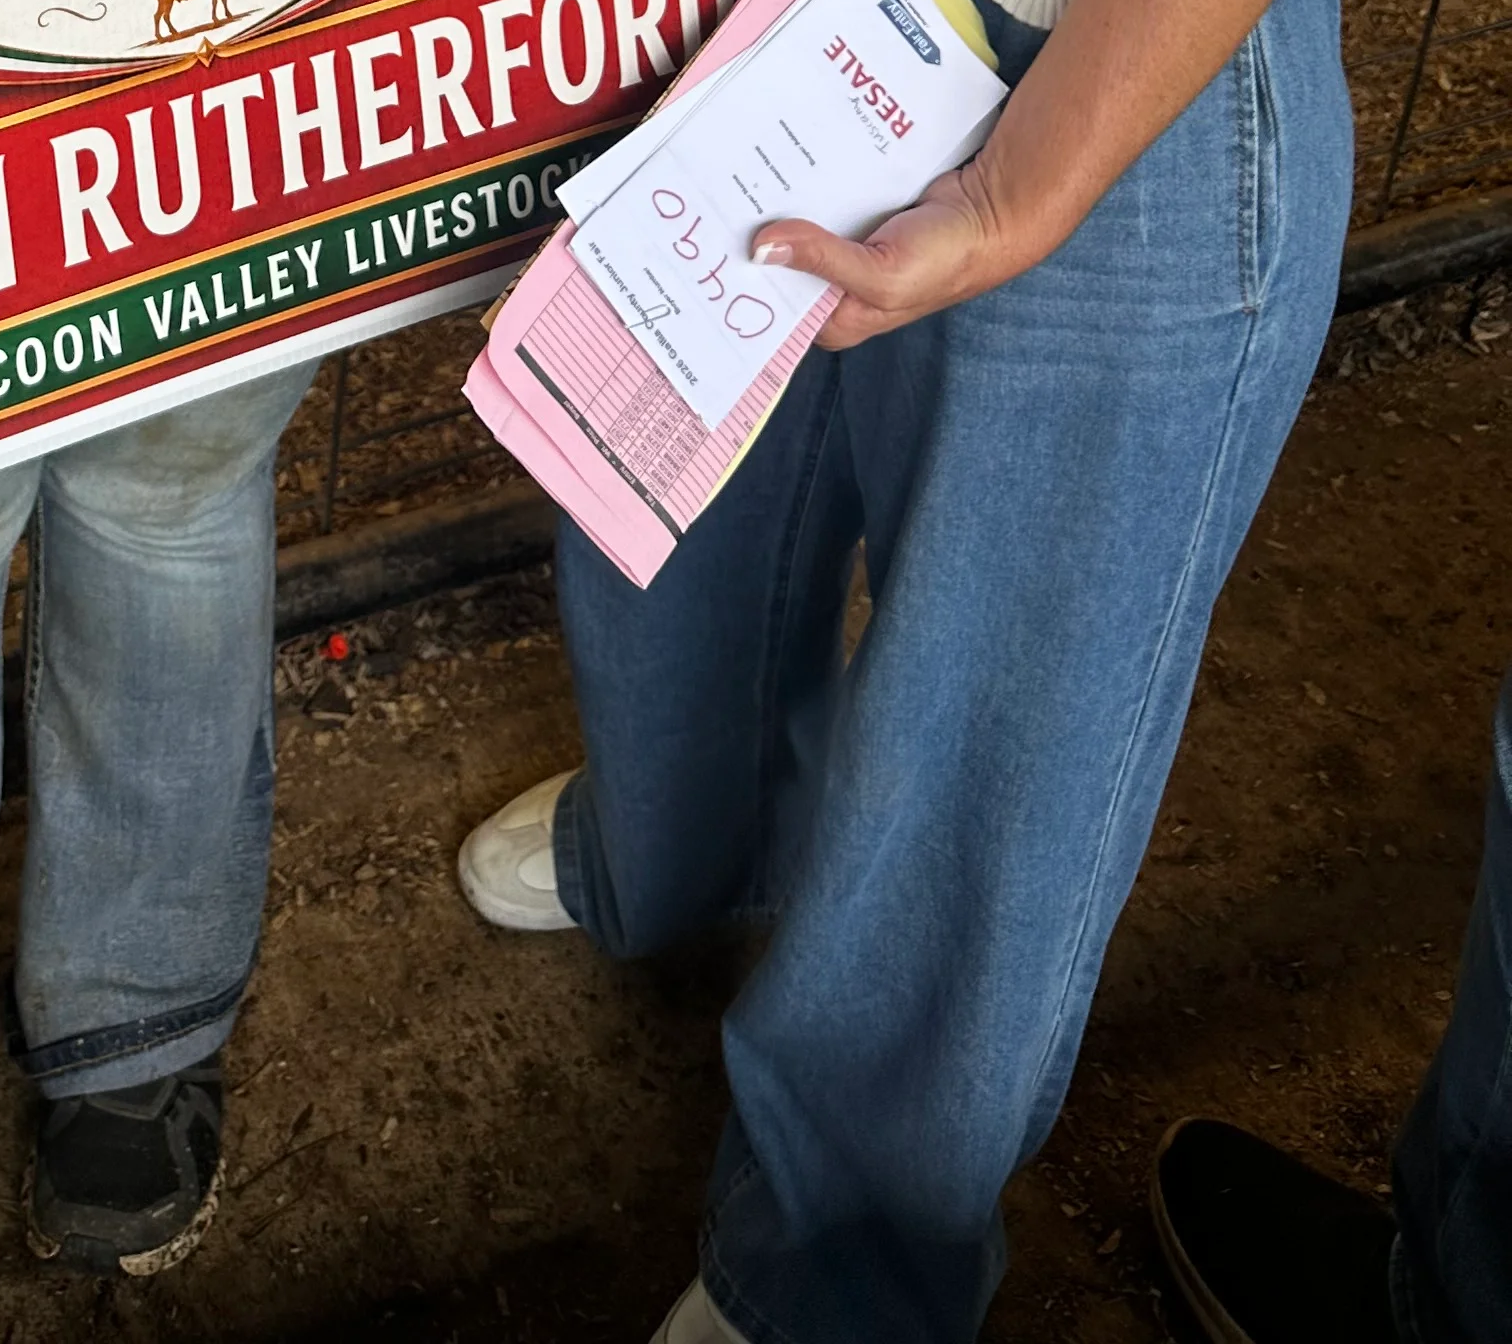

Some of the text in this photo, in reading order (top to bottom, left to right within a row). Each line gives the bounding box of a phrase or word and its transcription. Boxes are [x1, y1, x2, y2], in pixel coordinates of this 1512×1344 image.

[884, 0, 916, 34] Entry
[909, 31, 933, 56] Fair
[820, 33, 916, 139] RESALE
[585, 239, 606, 263] Fair
[651, 189, 776, 339] 0490
[143, 239, 323, 341] VALLEY
[600, 260, 629, 295] Junior
[624, 291, 657, 330] County
[650, 327, 679, 360] Gallia
[673, 357, 699, 386] 2026
